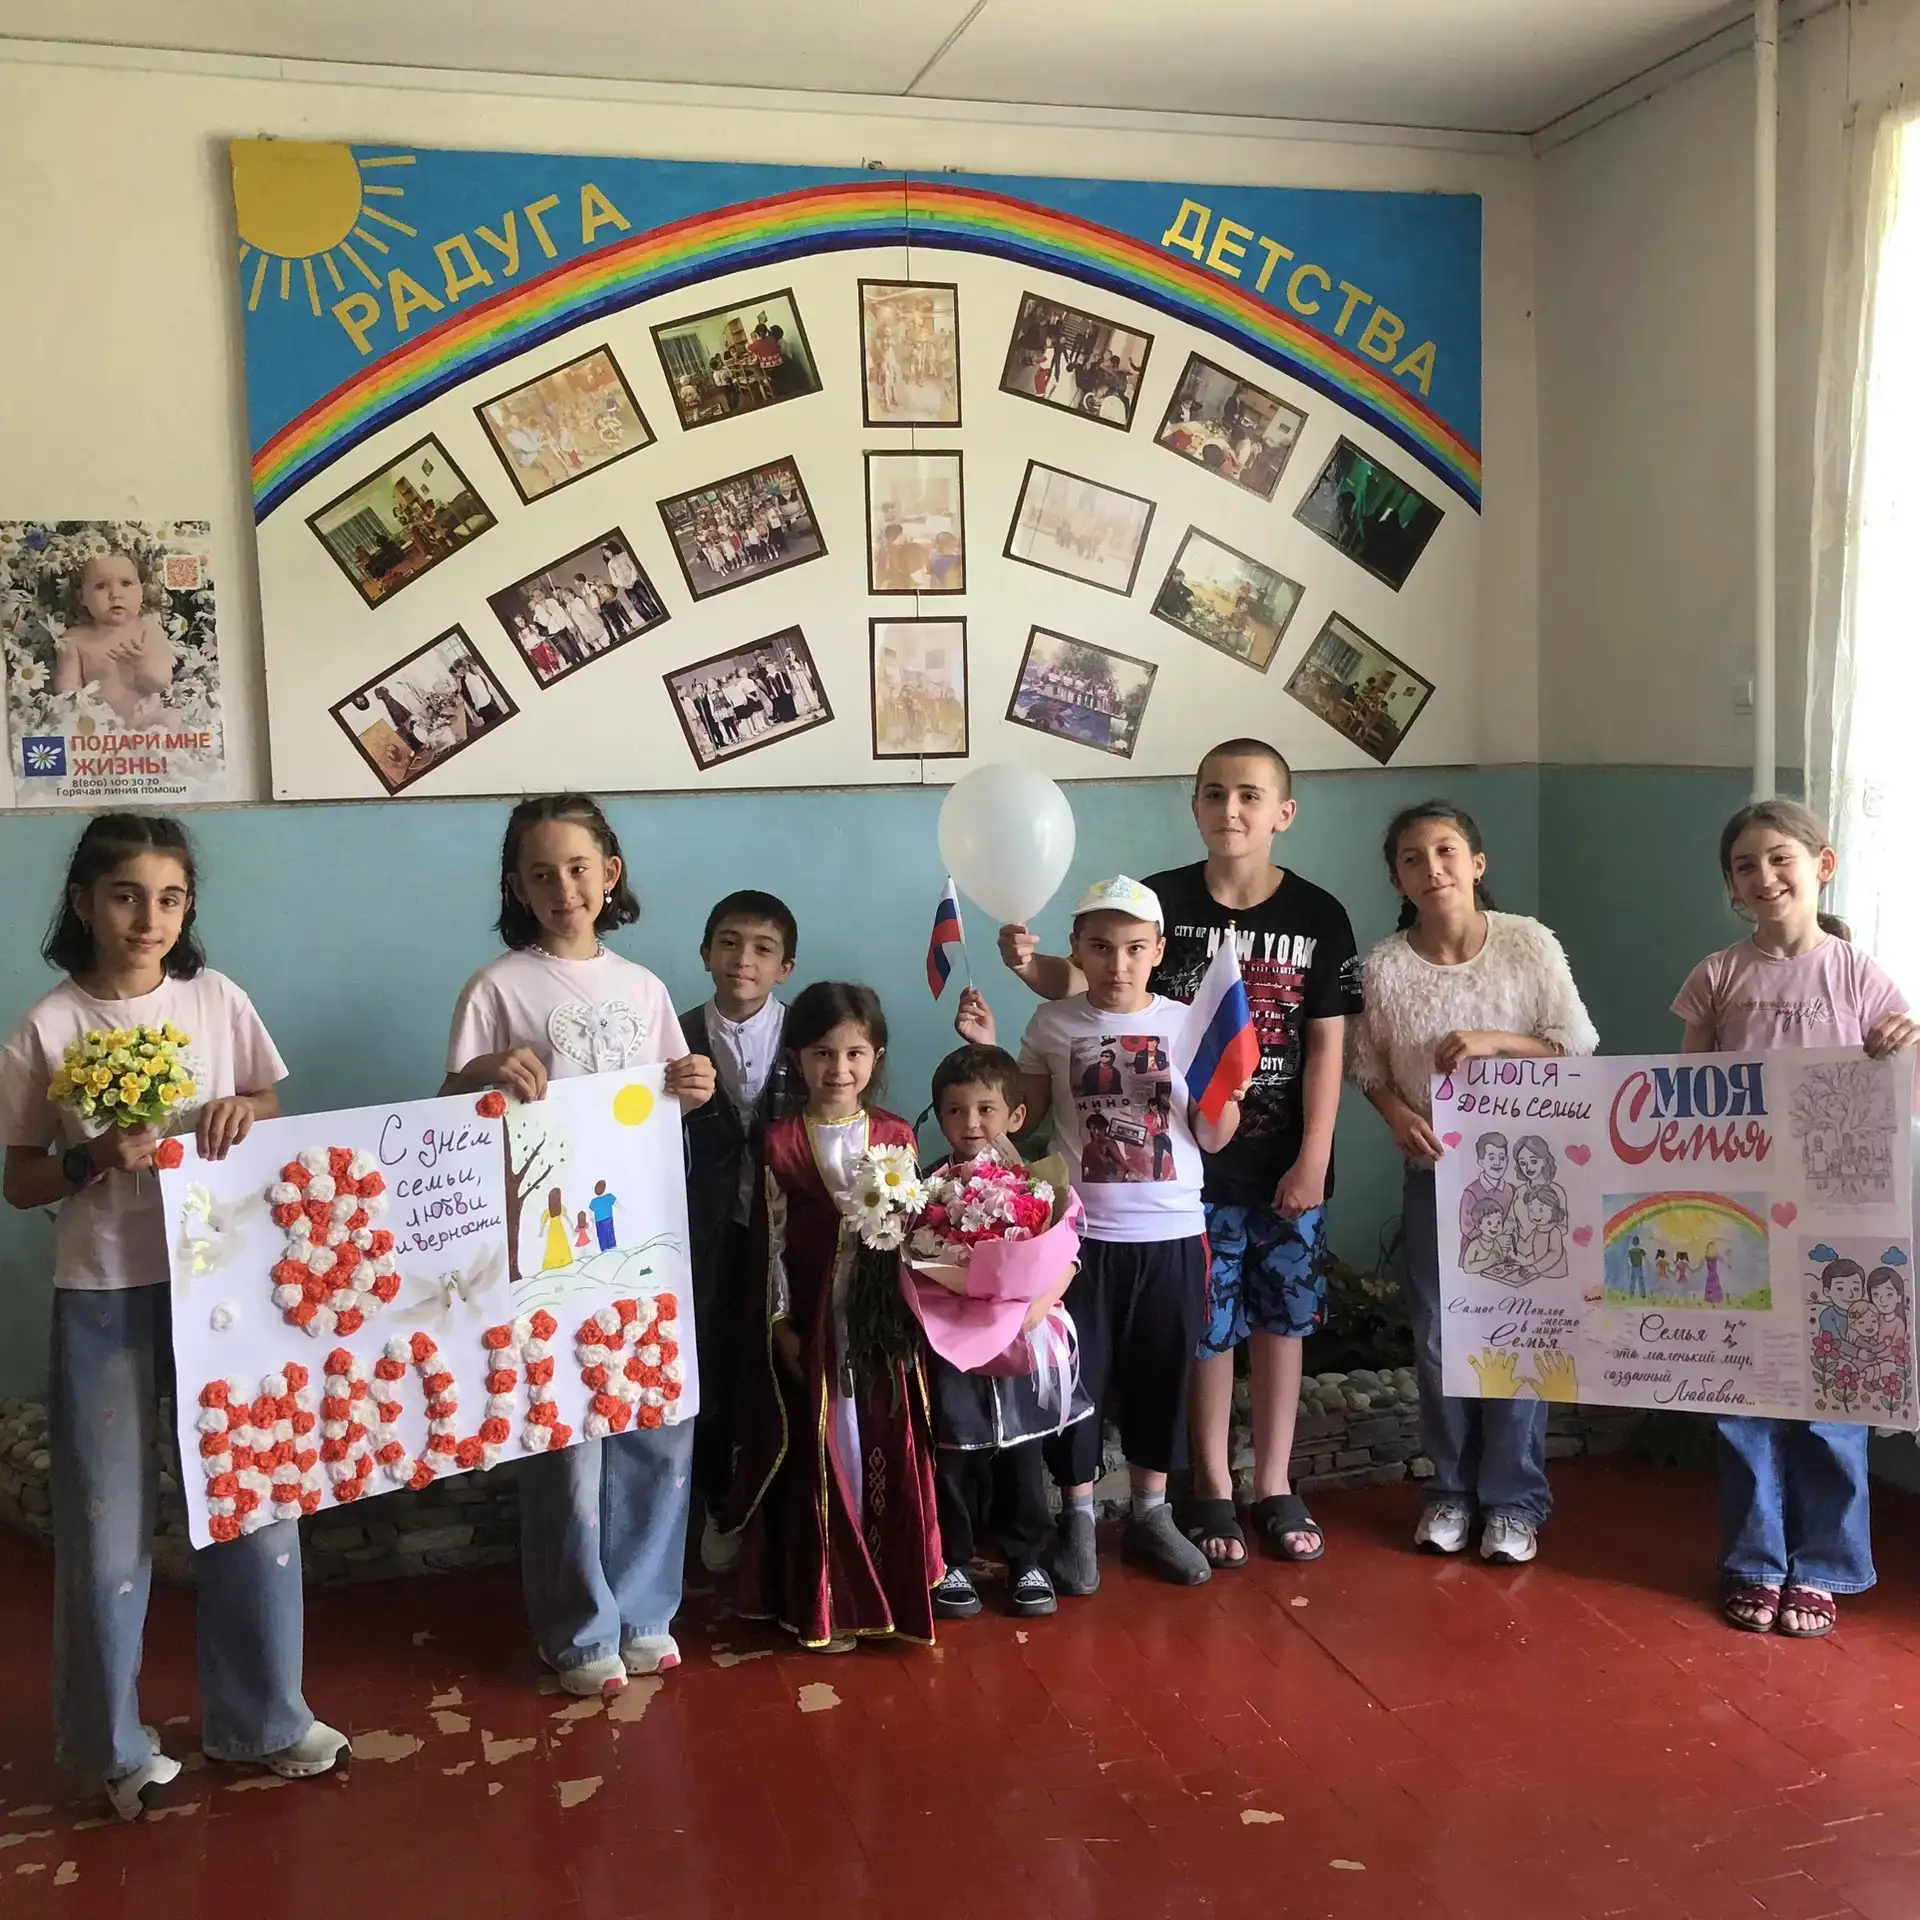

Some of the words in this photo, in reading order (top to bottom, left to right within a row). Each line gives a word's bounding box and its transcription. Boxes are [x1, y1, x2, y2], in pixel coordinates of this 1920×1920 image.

[332, 182, 632, 356] РАДУГА
[1161, 198, 1437, 397] ДЕТСТВА
[71, 734, 160, 754] ПОДАРИ
[166, 732, 210, 749] МНЕ
[73, 757, 168, 776] ЖИЗНЬ!
[56, 786, 102, 797] Горячая
[104, 786, 138, 796] линия
[141, 785, 187, 796] помощи
[72, 778, 107, 788] 8(800)
[111, 778, 128, 787] 100
[131, 778, 144, 787] 30
[147, 777, 160, 786] 70
[1174, 925, 1195, 938] CITY
[1195, 927, 1207, 939] OF
[1264, 932, 1318, 969] YORK
[1260, 1056, 1284, 1071] CITY
[1650, 1062, 1769, 1119] МОЯ
[1608, 1071, 1773, 1165] Семья
[397, 1167, 482, 1198] семьи,
[1639, 1313, 1708, 1343] Семья
[1643, 1350, 1717, 1364] маленький
[939, 1580, 972, 1590] adidas
[1017, 1579, 1050, 1589] adidas
